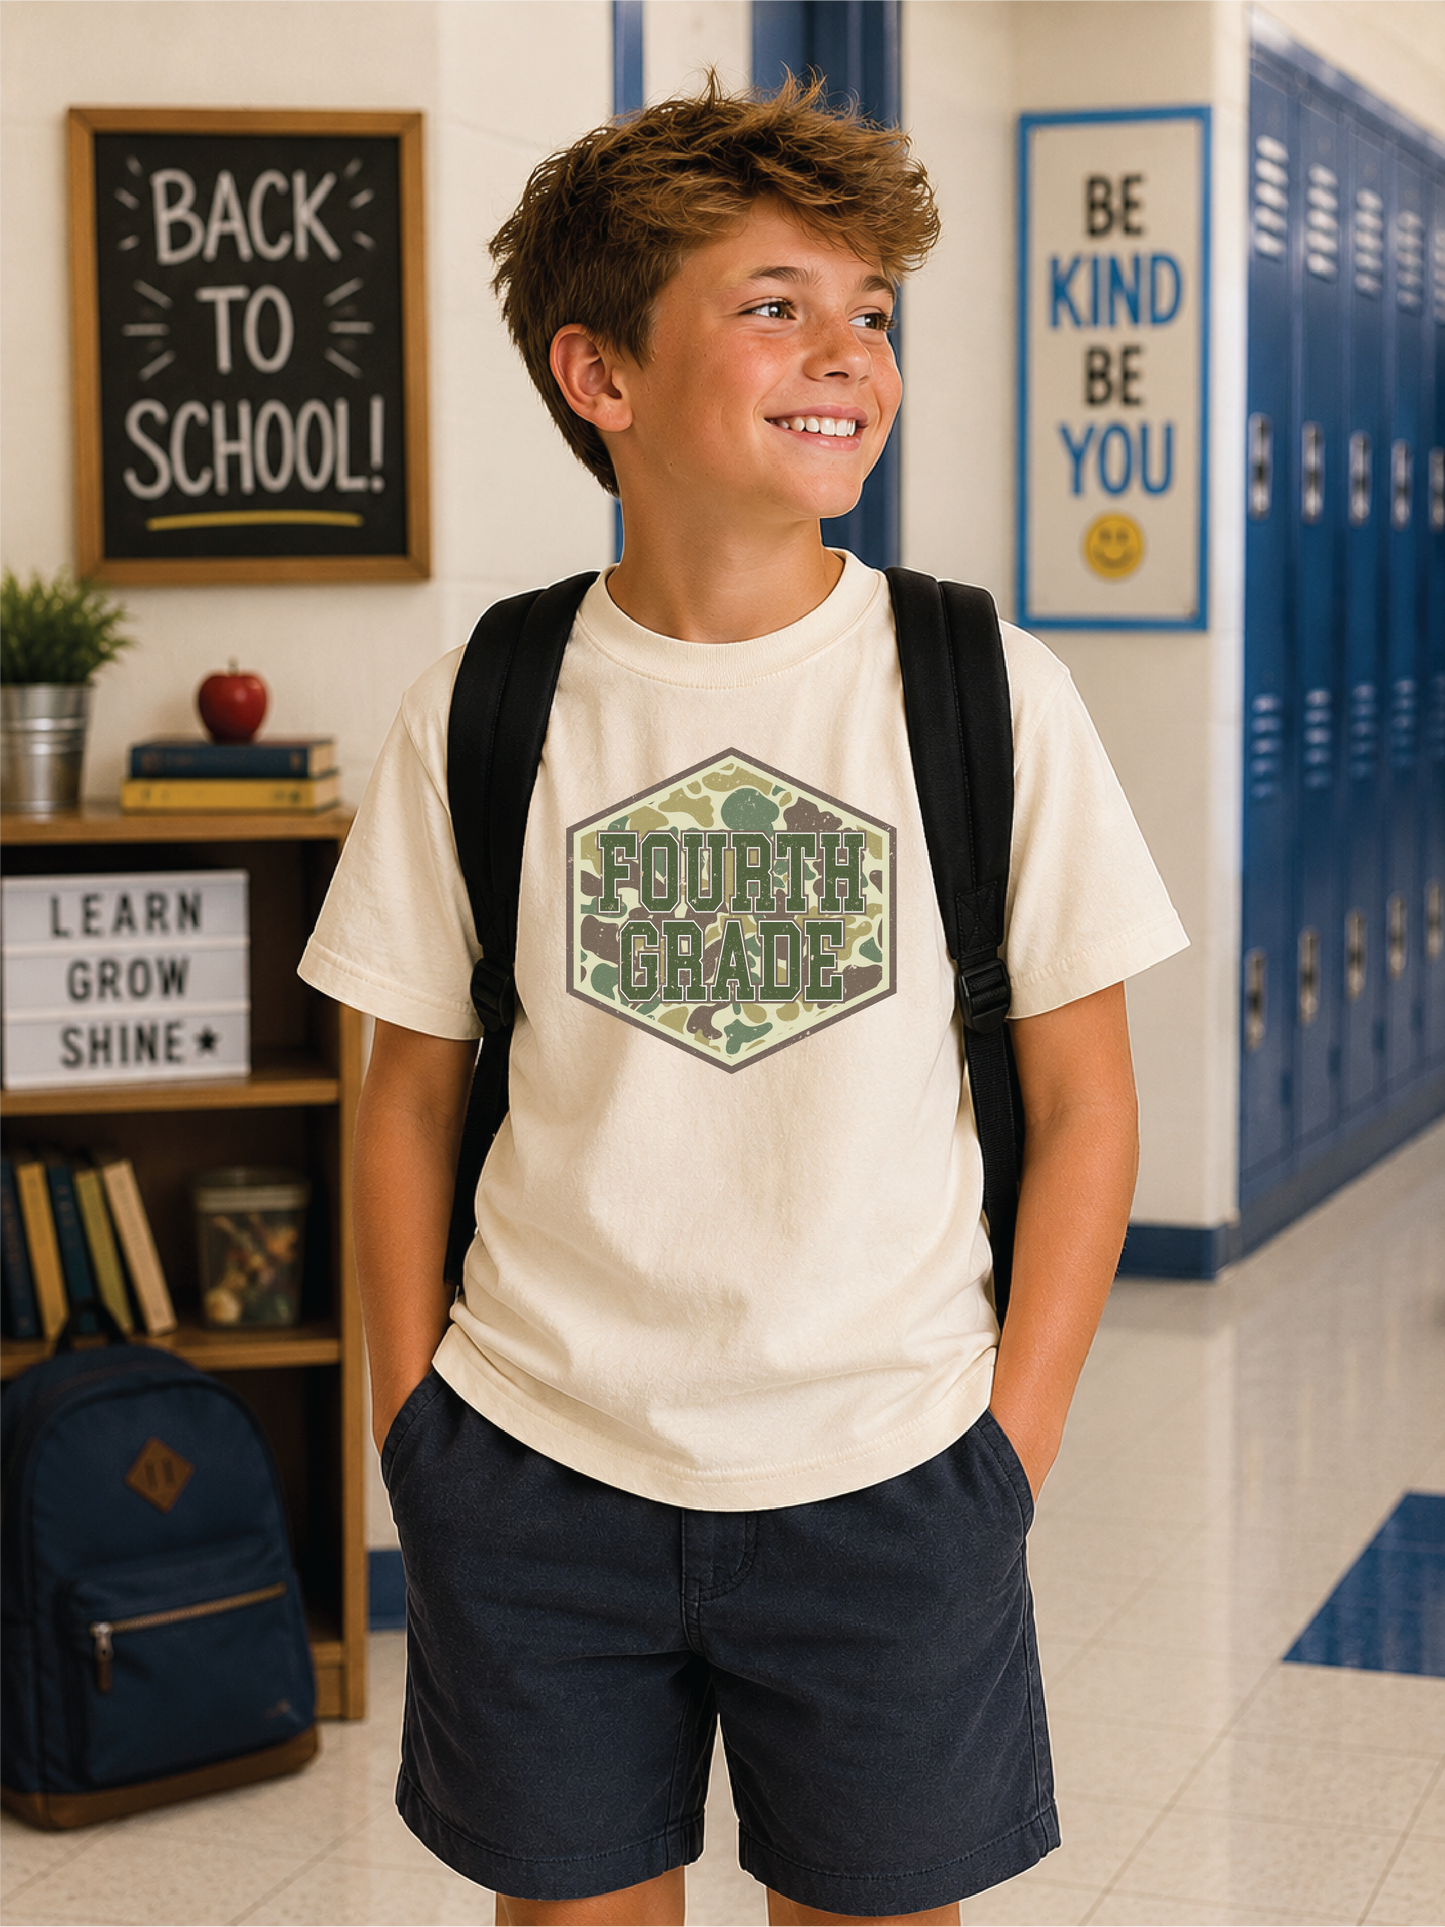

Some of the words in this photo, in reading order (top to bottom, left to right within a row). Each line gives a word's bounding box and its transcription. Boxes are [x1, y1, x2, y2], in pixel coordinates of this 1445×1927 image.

[151, 168, 342, 265] BACK
[1085, 173, 1145, 238] BE
[196, 283, 294, 374] TO
[1049, 252, 1182, 329] KIND
[1085, 344, 1144, 407] BE
[123, 394, 385, 499] SCHOOL!
[1059, 421, 1174, 497] YOU
[597, 831, 867, 915] FOURTH
[50, 892, 202, 938] LEARN
[67, 957, 189, 1003] GROW
[618, 919, 845, 1003] GRADE
[61, 1020, 185, 1068] SHINE
